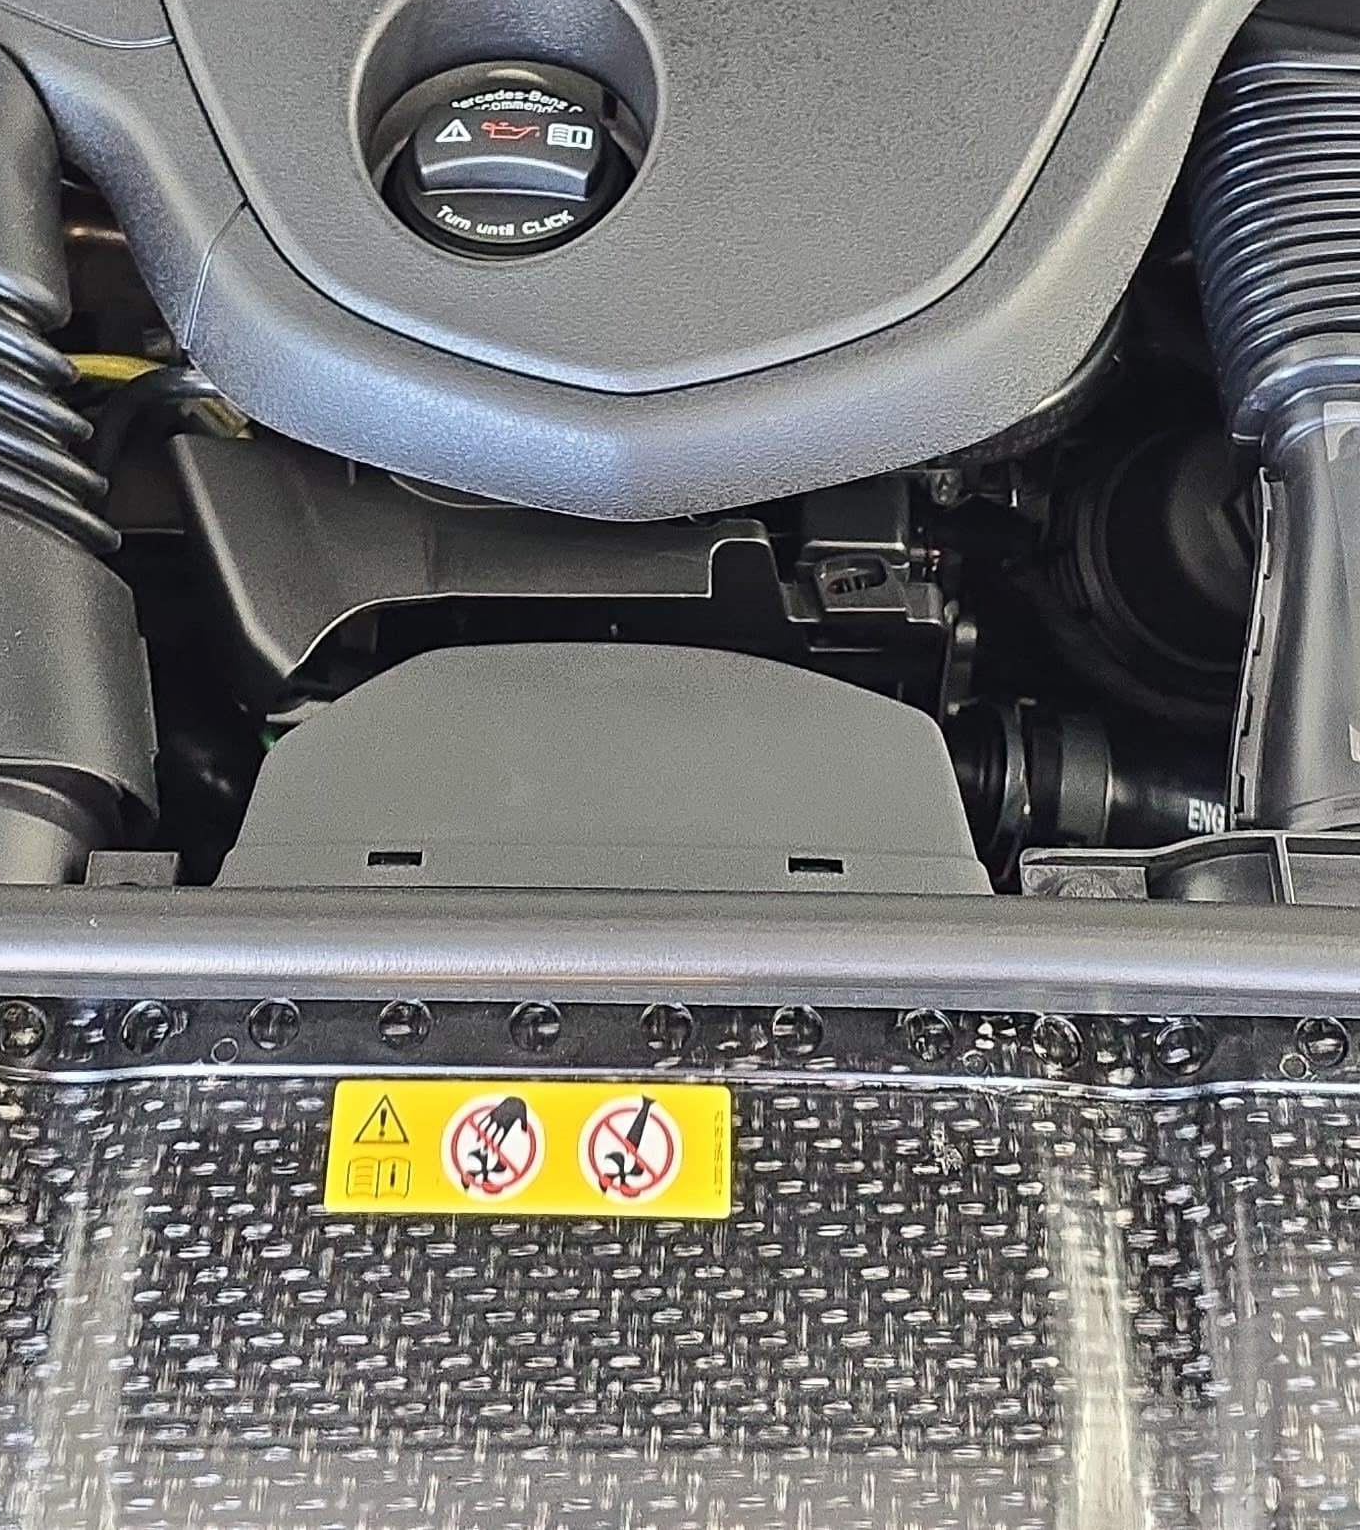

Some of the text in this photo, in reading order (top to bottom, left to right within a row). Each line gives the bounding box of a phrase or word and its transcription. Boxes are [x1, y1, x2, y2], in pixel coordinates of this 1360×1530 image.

[437, 205, 575, 236] Turn until CLICK
